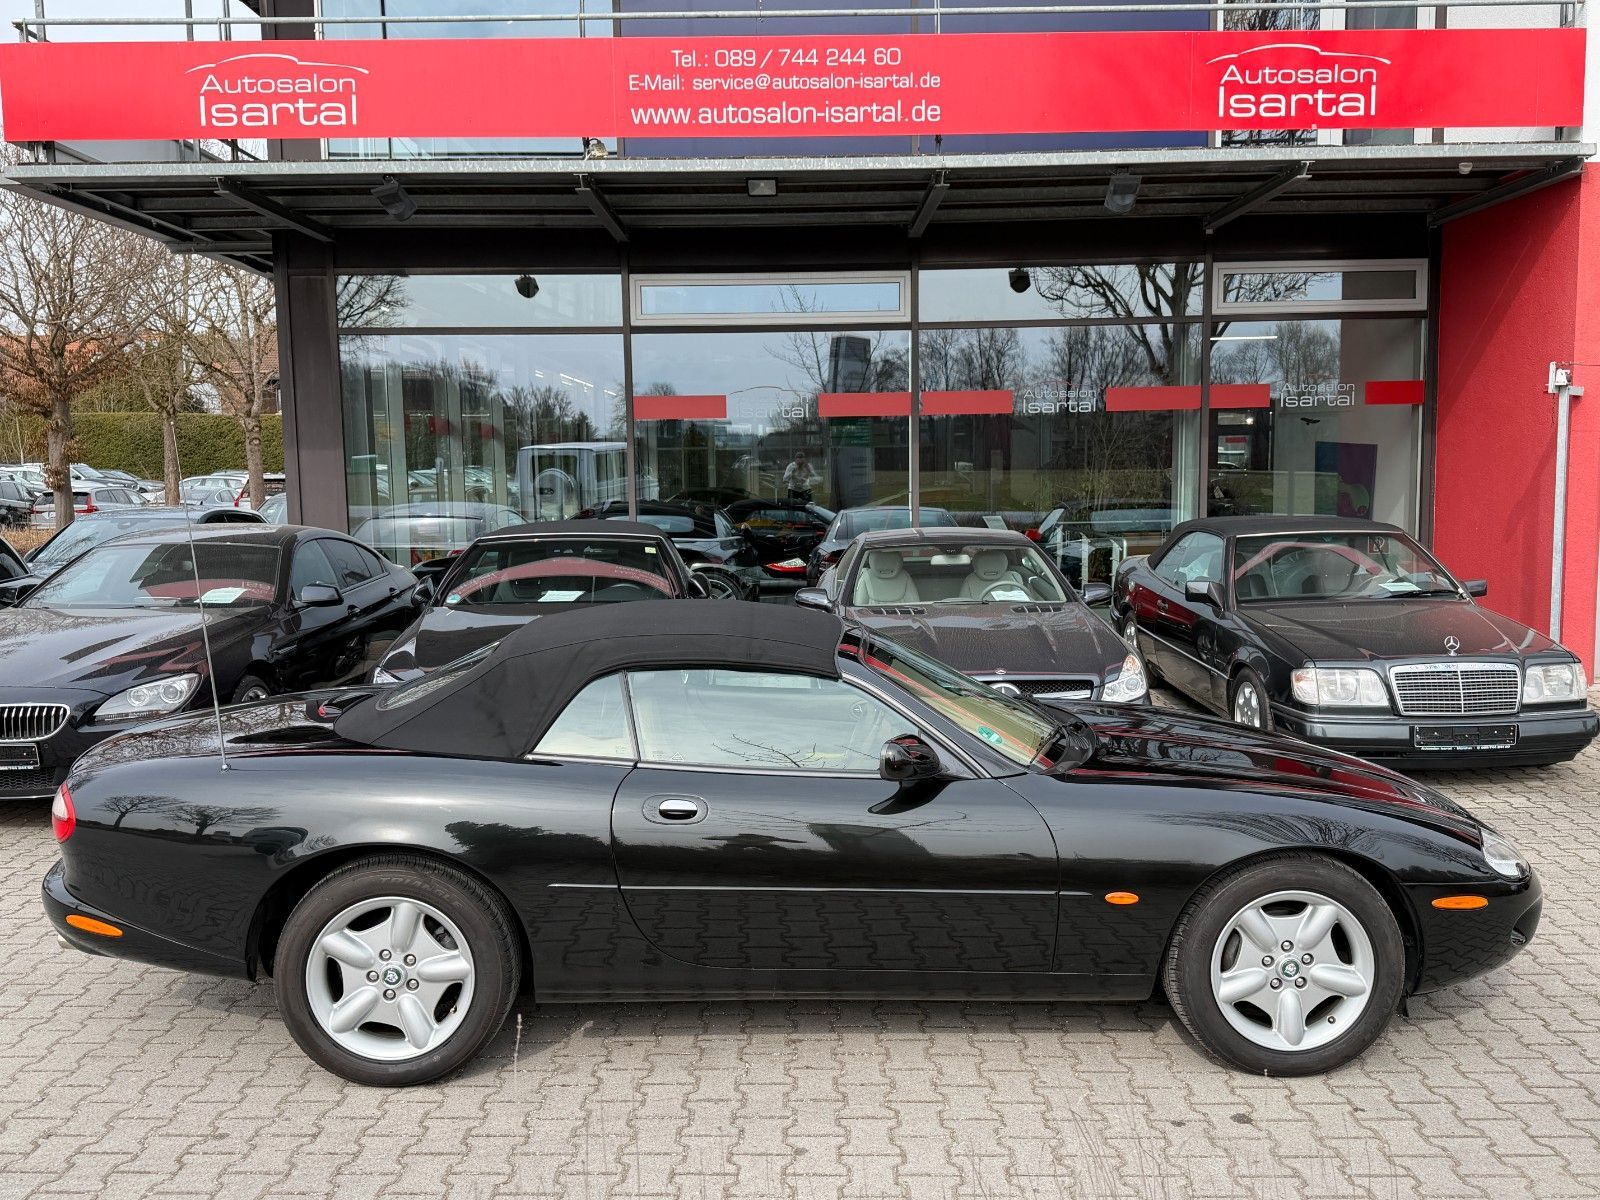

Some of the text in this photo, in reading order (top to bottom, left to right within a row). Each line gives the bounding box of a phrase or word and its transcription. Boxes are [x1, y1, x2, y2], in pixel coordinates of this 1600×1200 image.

[671, 47, 901, 69] Tel.: 089 / 744 244 60
[200, 73, 356, 94] Autosalon
[628, 72, 941, 91] E-Mail: service@autosalon-isartal.de
[1220, 64, 1377, 85] Autosalon
[200, 94, 357, 127] Isartal
[1218, 85, 1377, 118] Isartal
[630, 99, 941, 125] www.autosalon-isartal.de
[1023, 388, 1097, 399] Autosalon
[1281, 382, 1355, 393] Autosalon
[1022, 397, 1097, 414] Isartal
[1280, 391, 1355, 407] Isartal
[736, 403, 809, 418] Isartal
